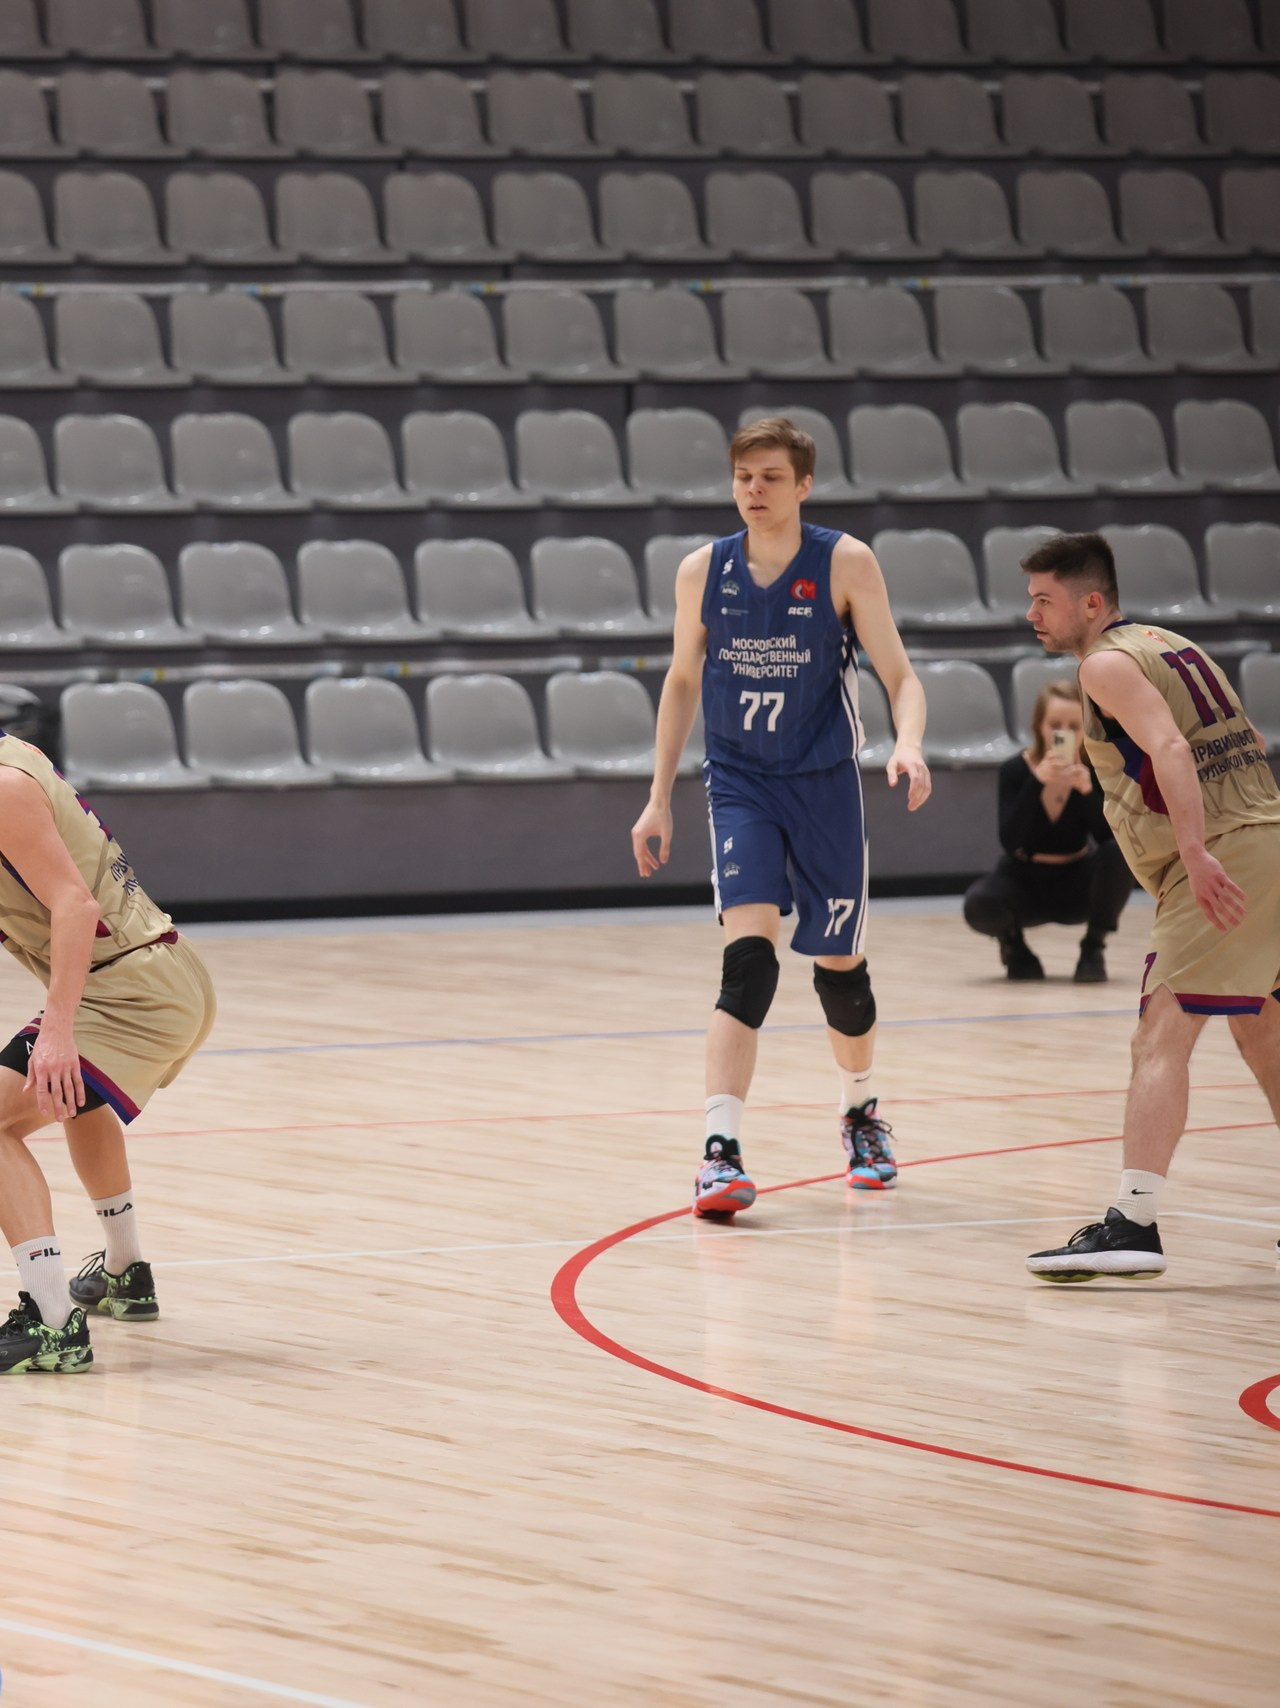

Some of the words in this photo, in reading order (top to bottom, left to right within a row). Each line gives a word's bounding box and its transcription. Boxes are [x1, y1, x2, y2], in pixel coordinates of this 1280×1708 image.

[732, 662, 799, 679] УНИВЕРСИТЕТ
[1160, 646, 1236, 728] 11
[739, 690, 785, 732] 77
